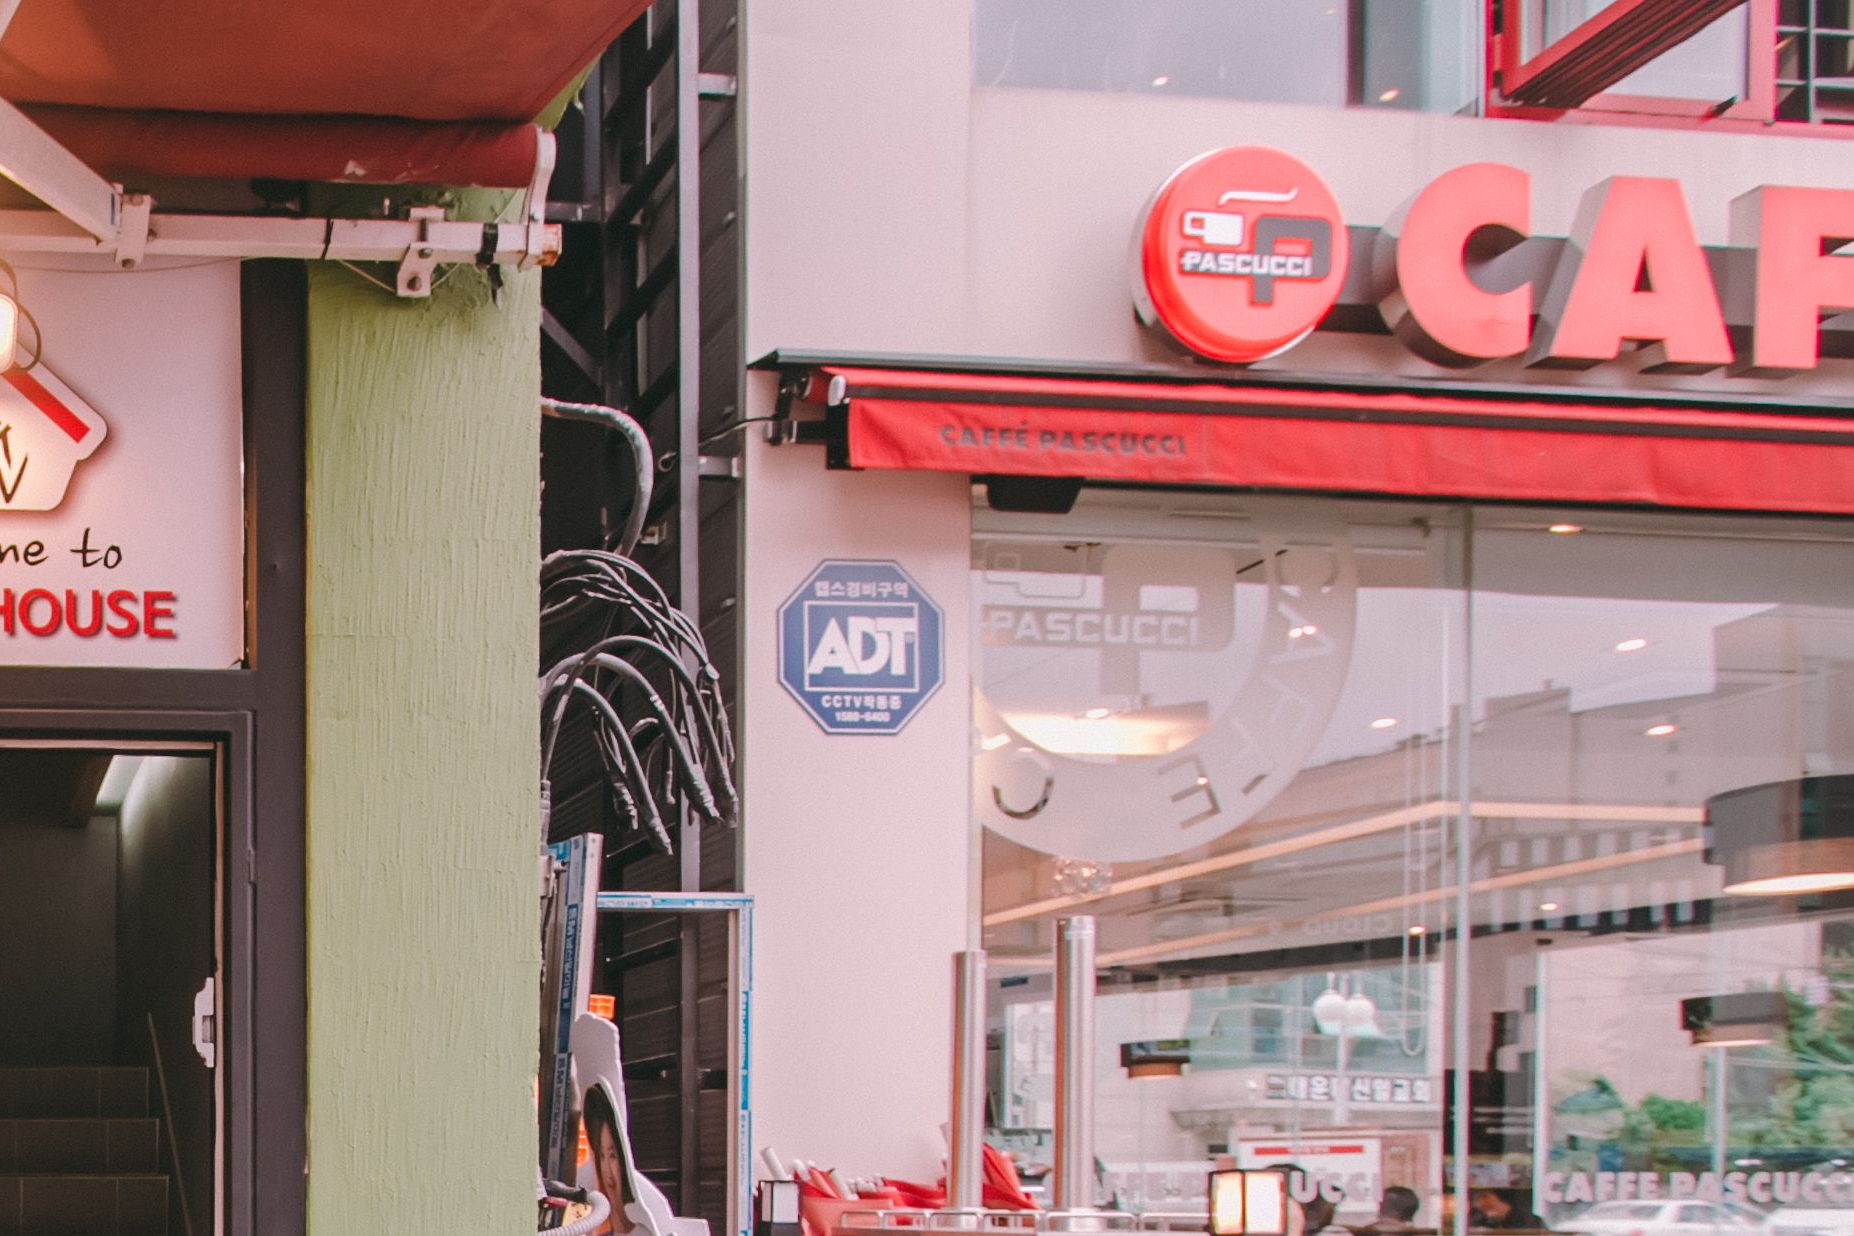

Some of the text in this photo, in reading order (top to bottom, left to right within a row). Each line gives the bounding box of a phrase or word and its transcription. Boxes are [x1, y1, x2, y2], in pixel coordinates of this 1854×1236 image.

[1181, 250, 1313, 277] PASCUCCI
[1038, 430, 1186, 457] PASCUCCI
[70, 527, 124, 570] to
[807, 616, 920, 676] ADT
[989, 609, 1199, 647] PASCUCCI
